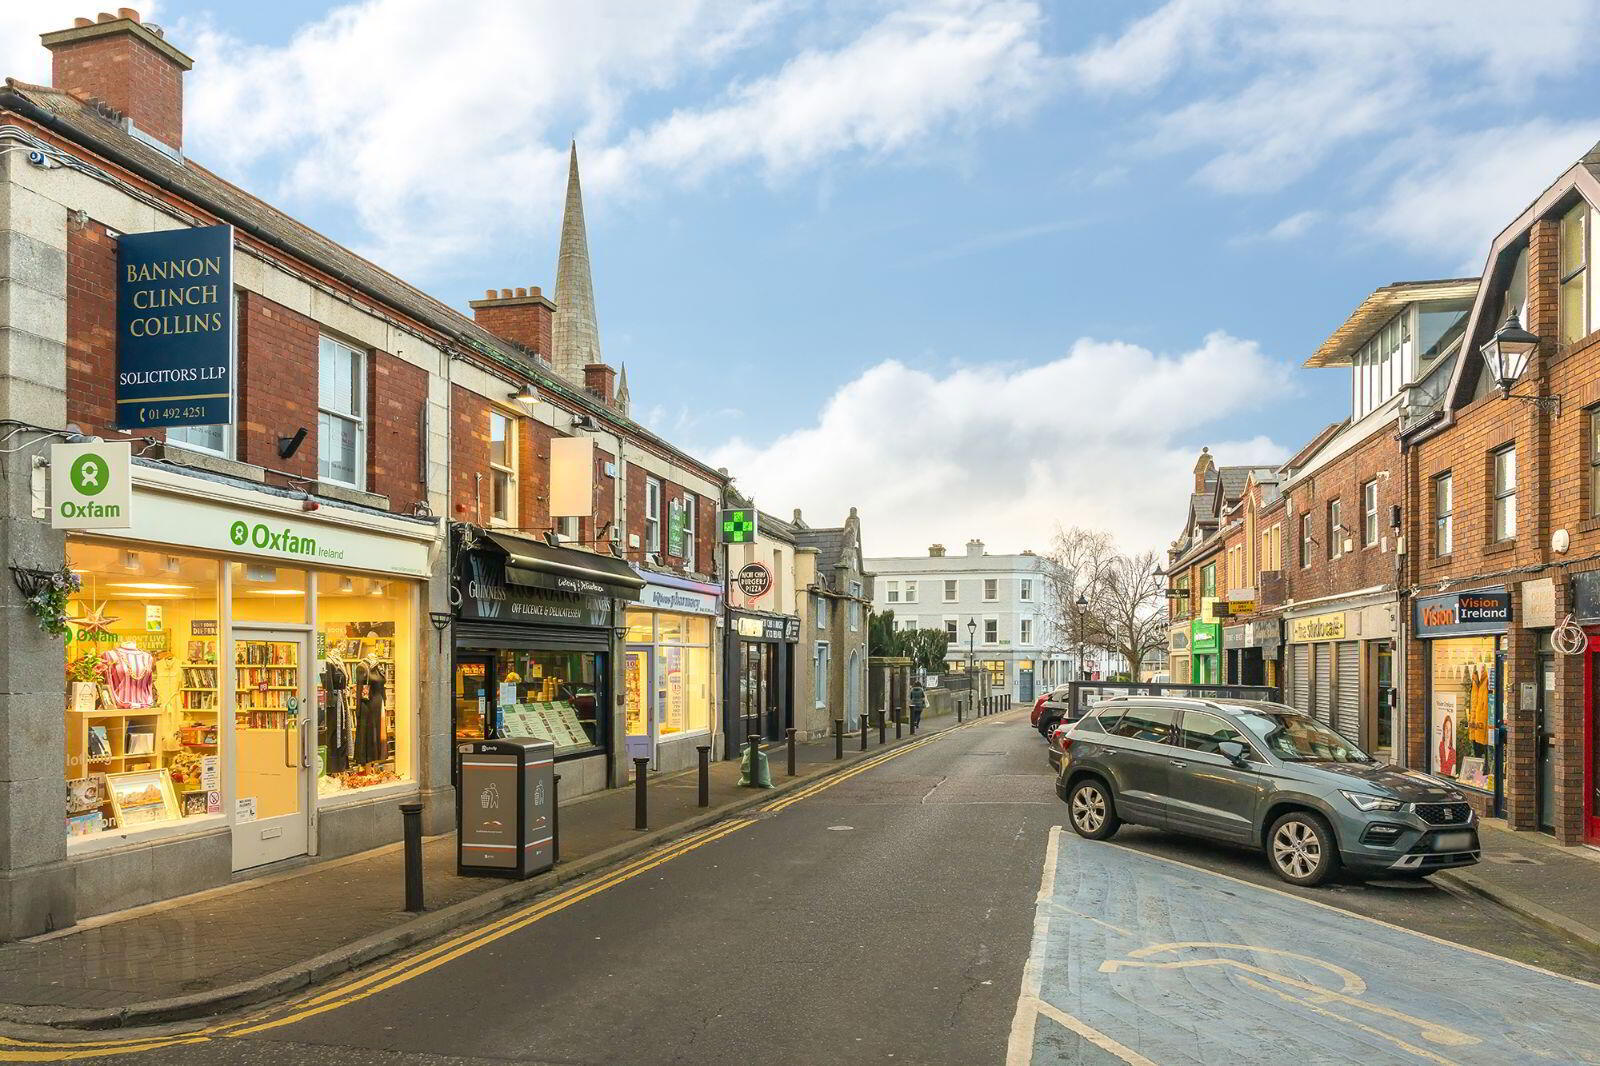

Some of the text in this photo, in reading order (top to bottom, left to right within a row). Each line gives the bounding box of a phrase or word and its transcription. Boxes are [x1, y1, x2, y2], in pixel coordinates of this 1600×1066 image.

[127, 256, 221, 283] BANNON
[133, 284, 218, 309] CLINCH
[130, 312, 222, 337] COLLINS
[119, 366, 226, 386] SOLICITORS LLP
[148, 406, 205, 420] 01 492 4251
[60, 501, 120, 519] Oxfam
[251, 523, 344, 560] Oxfam Ireland
[468, 580, 507, 601] GUINNESS
[511, 602, 522, 614] OFF
[522, 603, 544, 616] LICENCE
[549, 607, 582, 618] DELICATESSEN
[1460, 597, 1499, 608] Vision
[1421, 605, 1453, 627] Vision
[1460, 607, 1507, 619] Ireland
[76, 628, 118, 643] Oxfam
